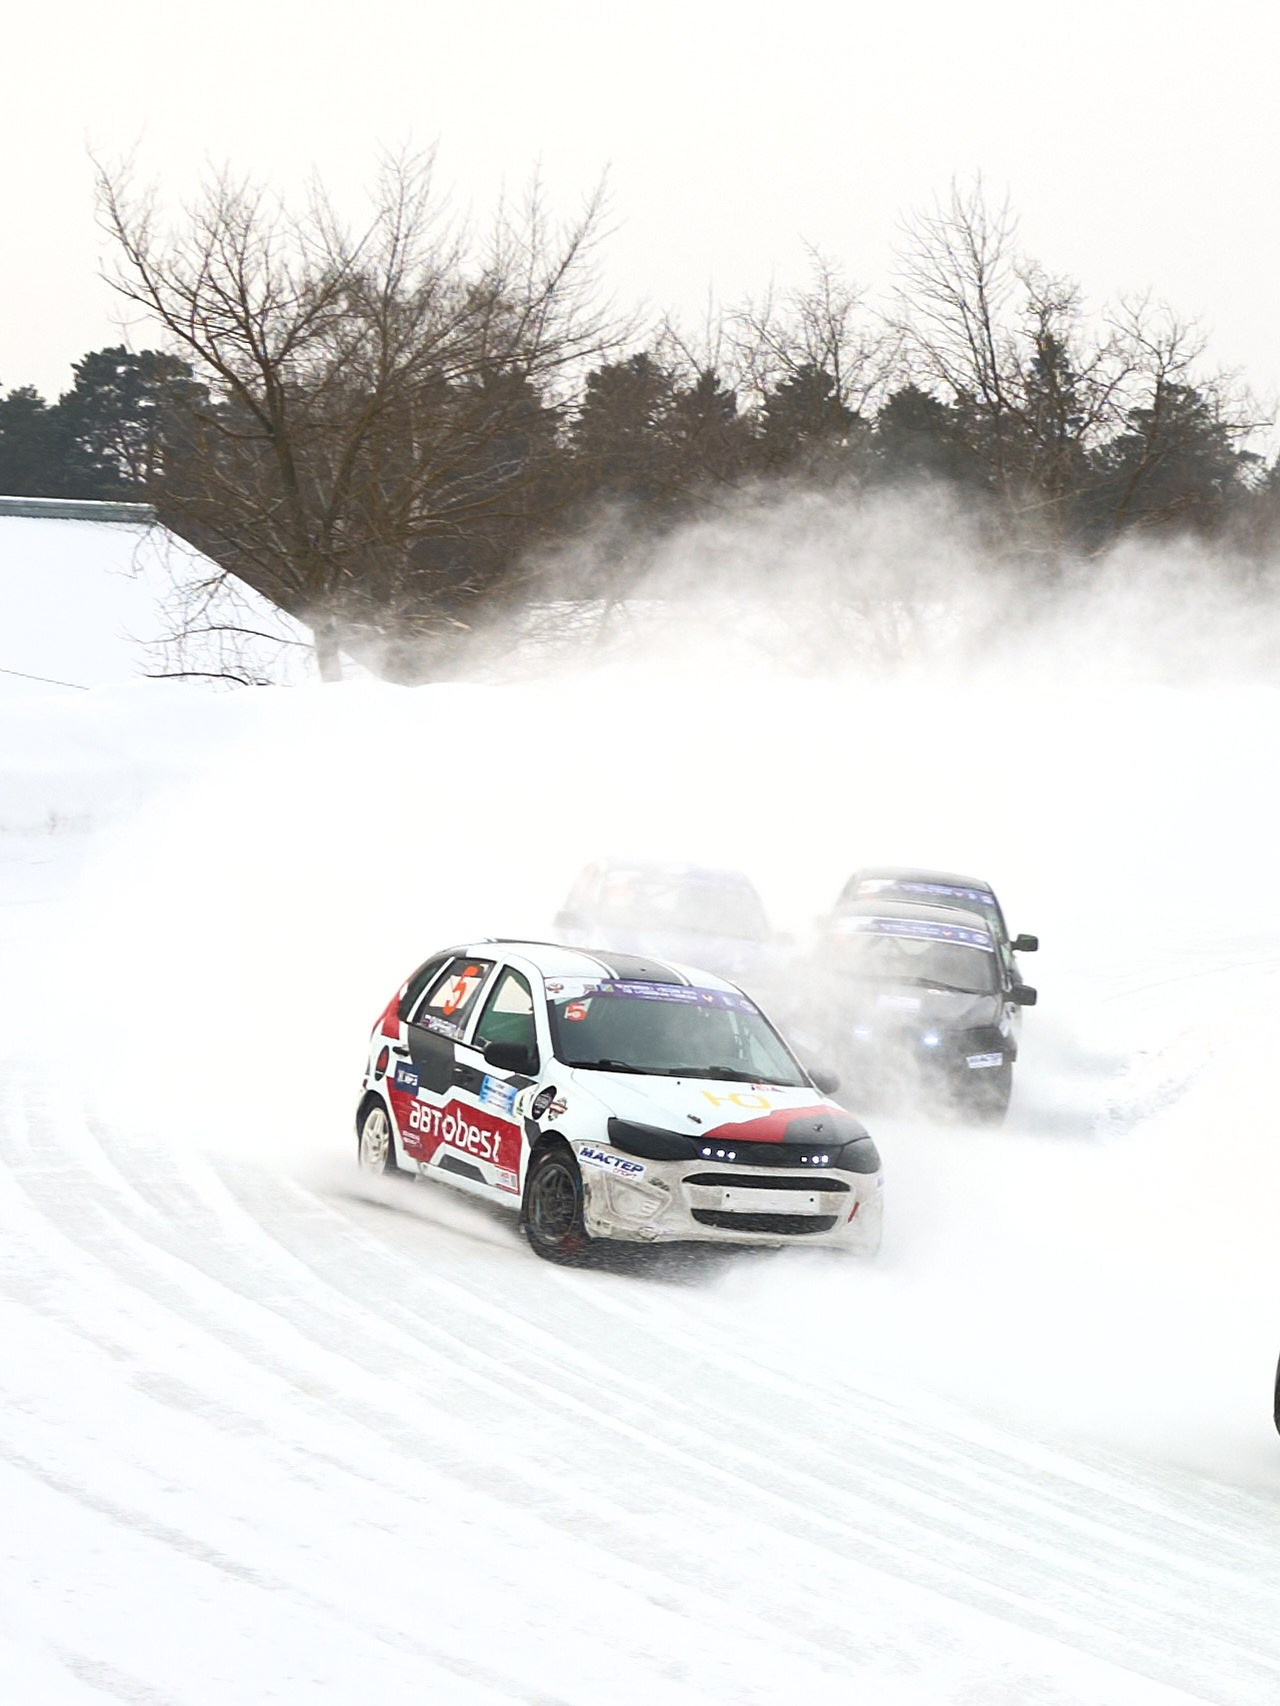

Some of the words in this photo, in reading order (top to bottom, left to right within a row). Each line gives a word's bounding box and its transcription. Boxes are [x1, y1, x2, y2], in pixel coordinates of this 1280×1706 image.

[443, 966, 479, 1015] 5
[566, 1002, 588, 1022] 5
[579, 1147, 645, 1173] МАСТЕР
